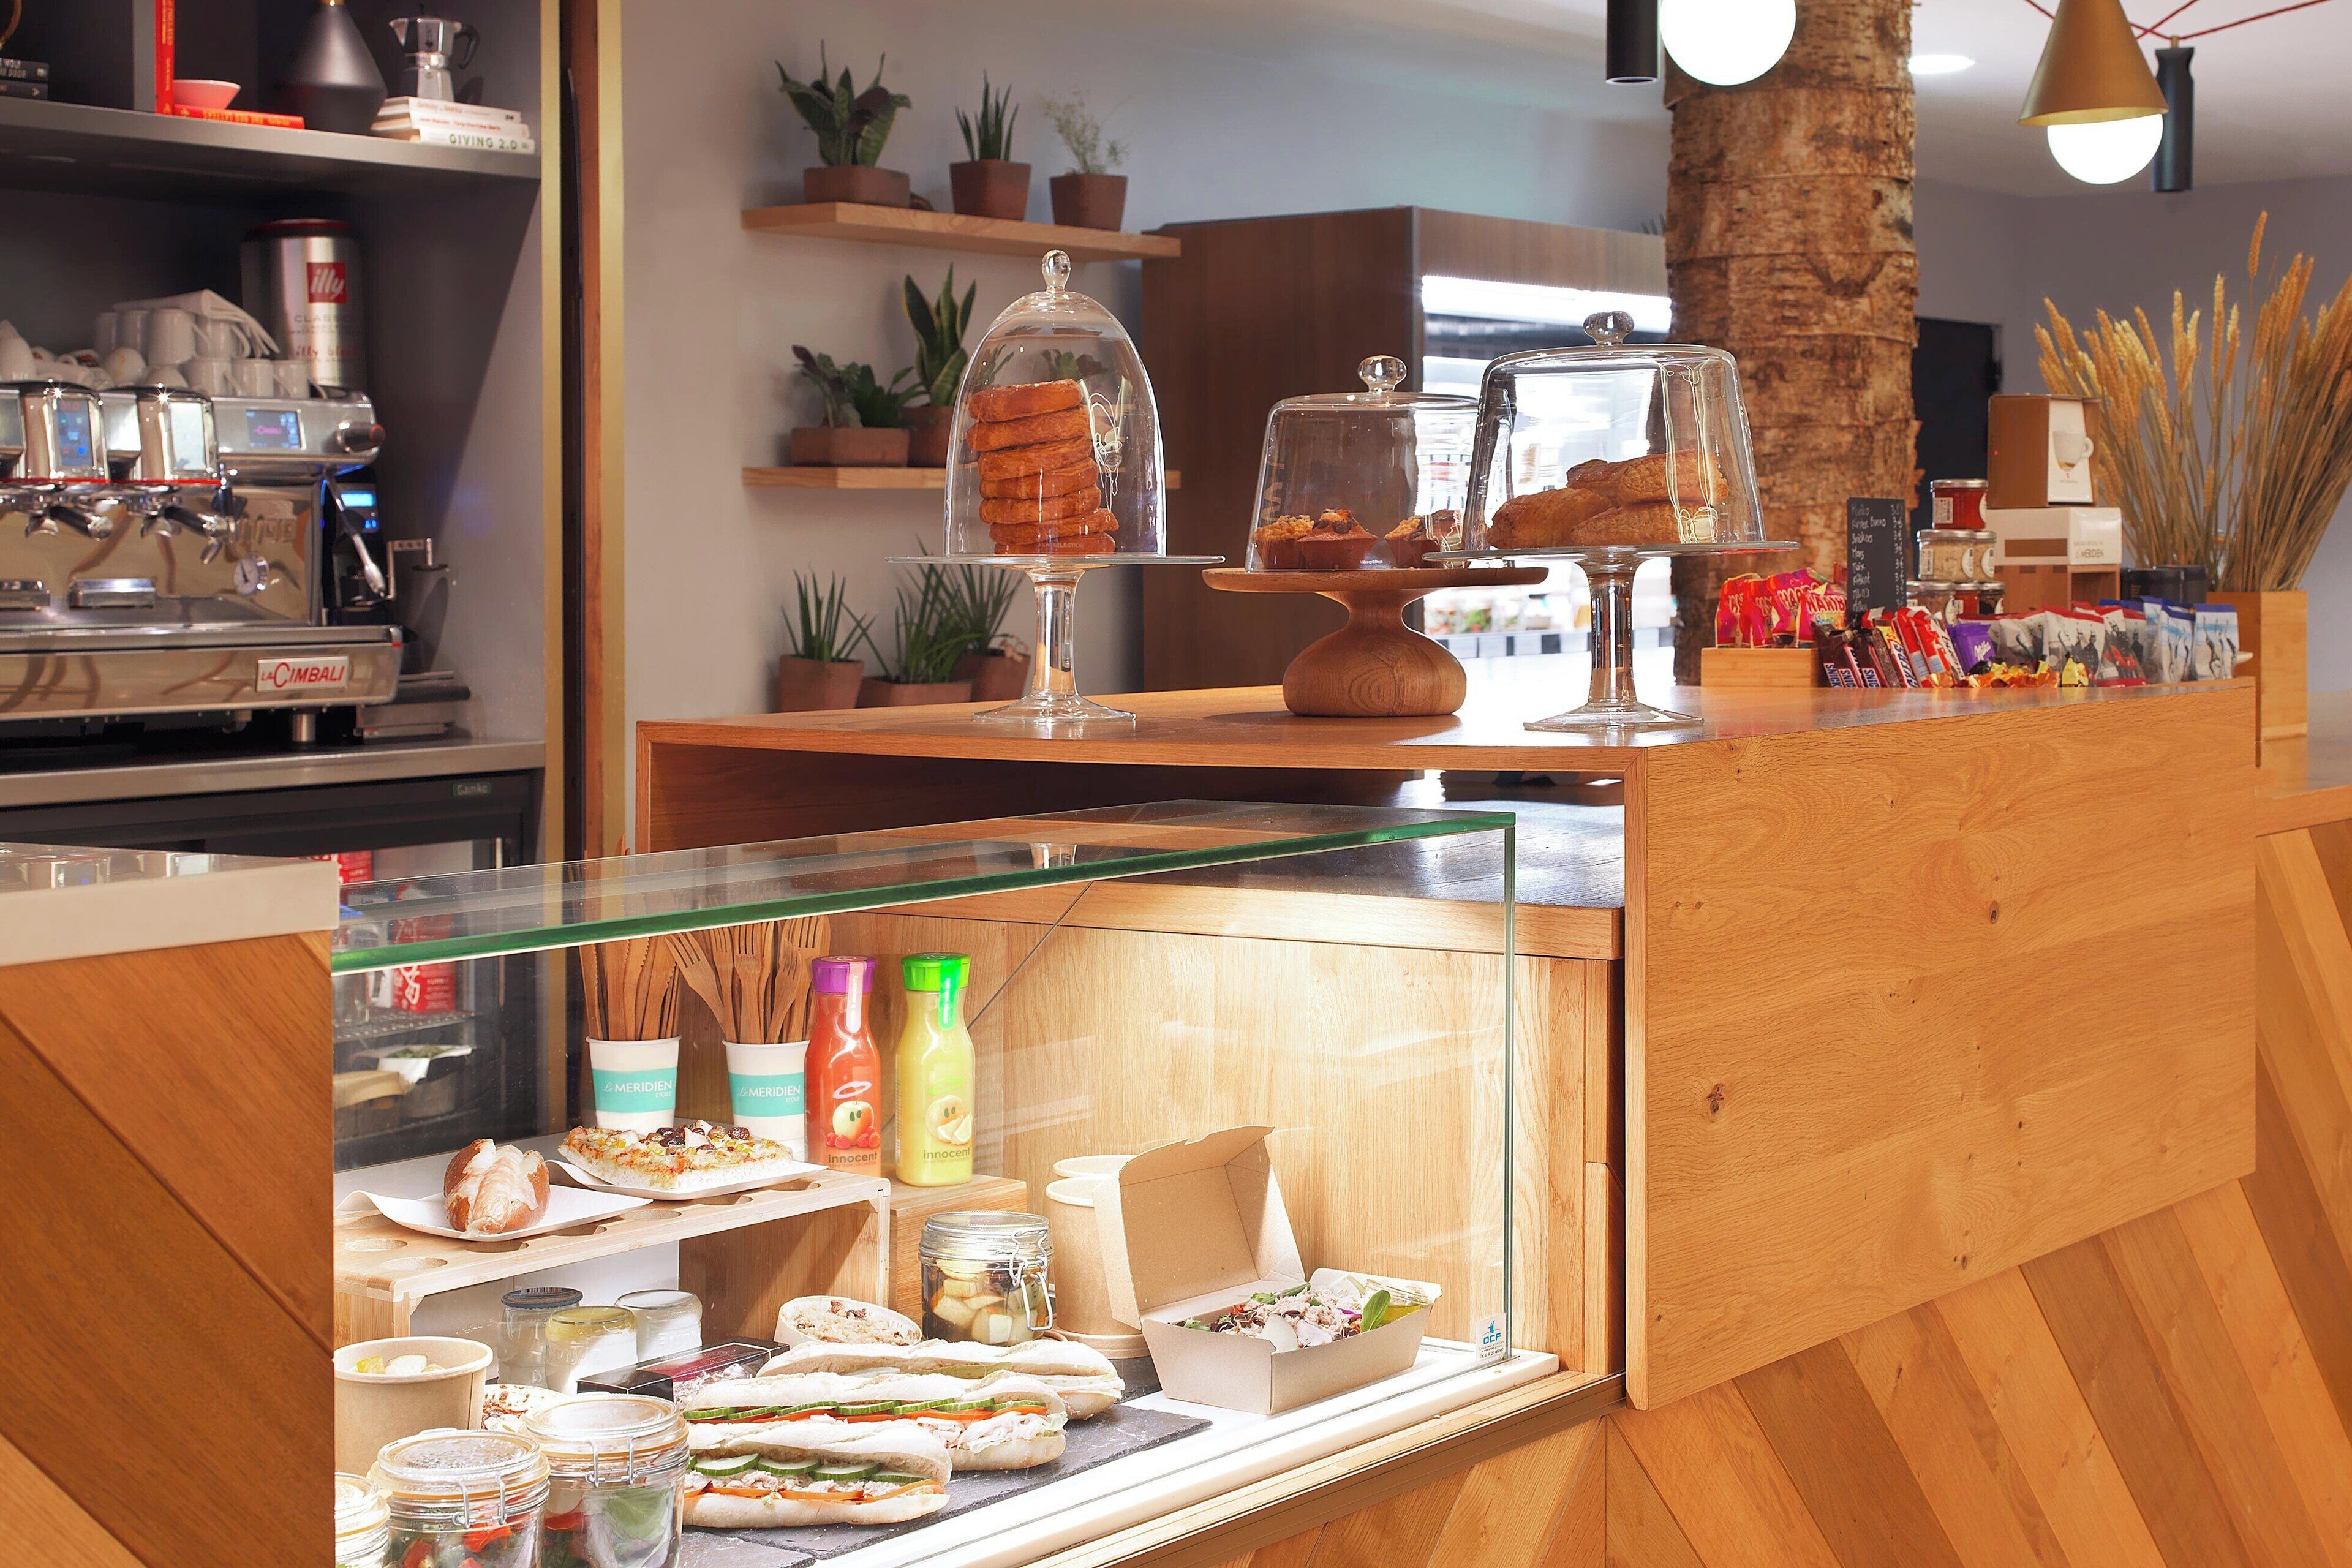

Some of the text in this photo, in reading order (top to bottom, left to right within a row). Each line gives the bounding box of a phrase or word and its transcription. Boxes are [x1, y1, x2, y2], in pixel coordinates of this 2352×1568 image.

[449, 134, 518, 149] GIVING 2.0
[310, 268, 344, 301] illy
[1807, 595, 1846, 614] HARIB
[274, 662, 345, 688] CIMBALI
[1825, 664, 1842, 687] SNICK
[614, 1080, 672, 1093] MERIDIEN
[748, 1085, 801, 1097] MERIDIEN
[828, 1152, 878, 1163] innocent
[923, 1147, 970, 1159] innocent
[1483, 1332, 1501, 1344] OCF
